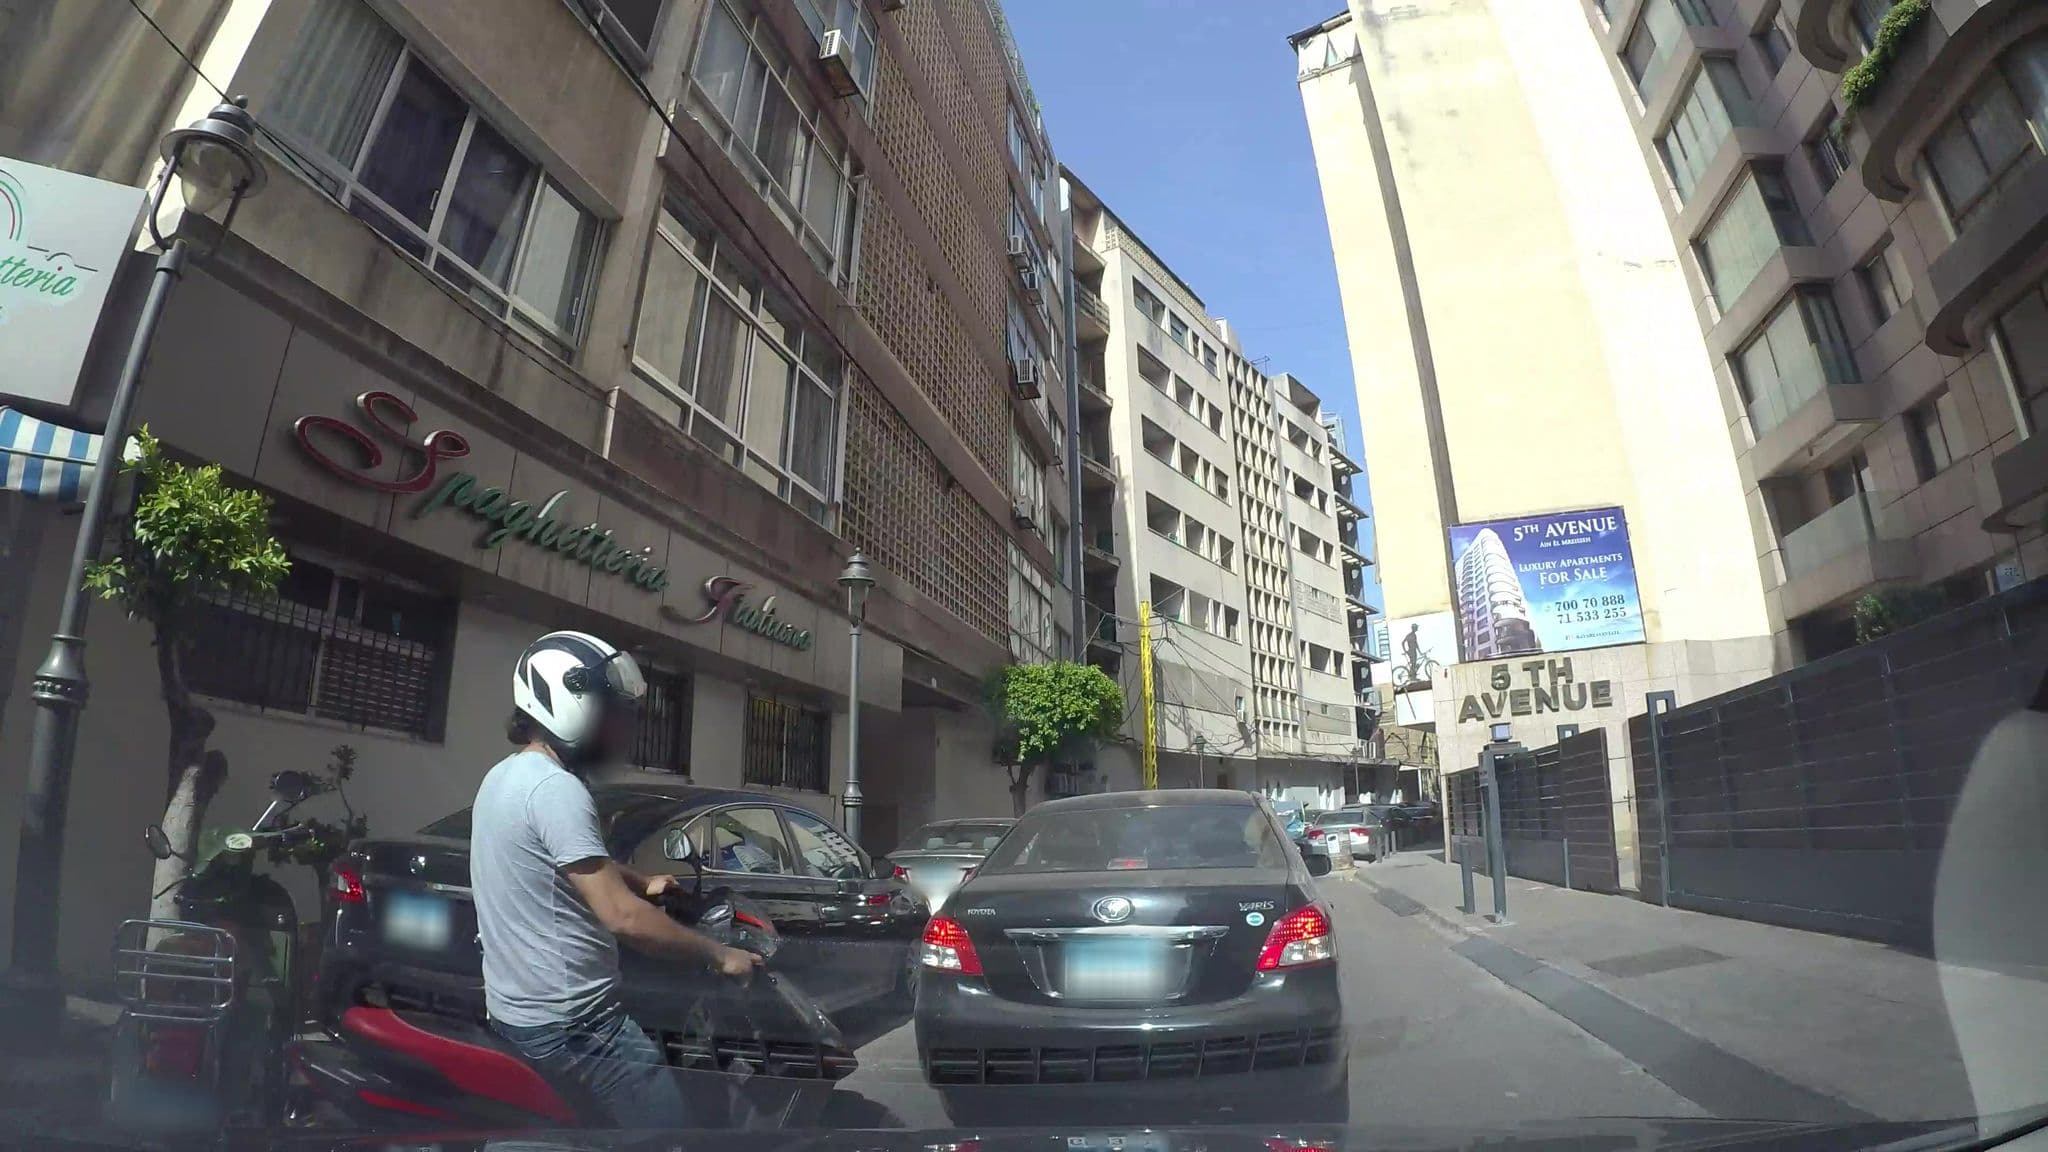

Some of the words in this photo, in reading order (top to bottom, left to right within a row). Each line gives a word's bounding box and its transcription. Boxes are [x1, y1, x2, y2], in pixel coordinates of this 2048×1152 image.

[1513, 523, 1539, 542] 5TH
[1545, 516, 1617, 538] AVENUE
[1519, 559, 1557, 573] LUXURY
[1560, 553, 1623, 568] APARTMENTS
[1540, 571, 1570, 585] FOR
[1574, 567, 1608, 580] SALE
[1555, 600, 1578, 611] 700
[1583, 597, 1598, 608] 70
[1602, 594, 1625, 606] 888
[1557, 613, 1571, 624] 71
[1577, 609, 1599, 622] 533
[1604, 606, 1626, 619] 255
[1458, 680, 1613, 724] AVENUE
[1238, 900, 1275, 911] YARIS
